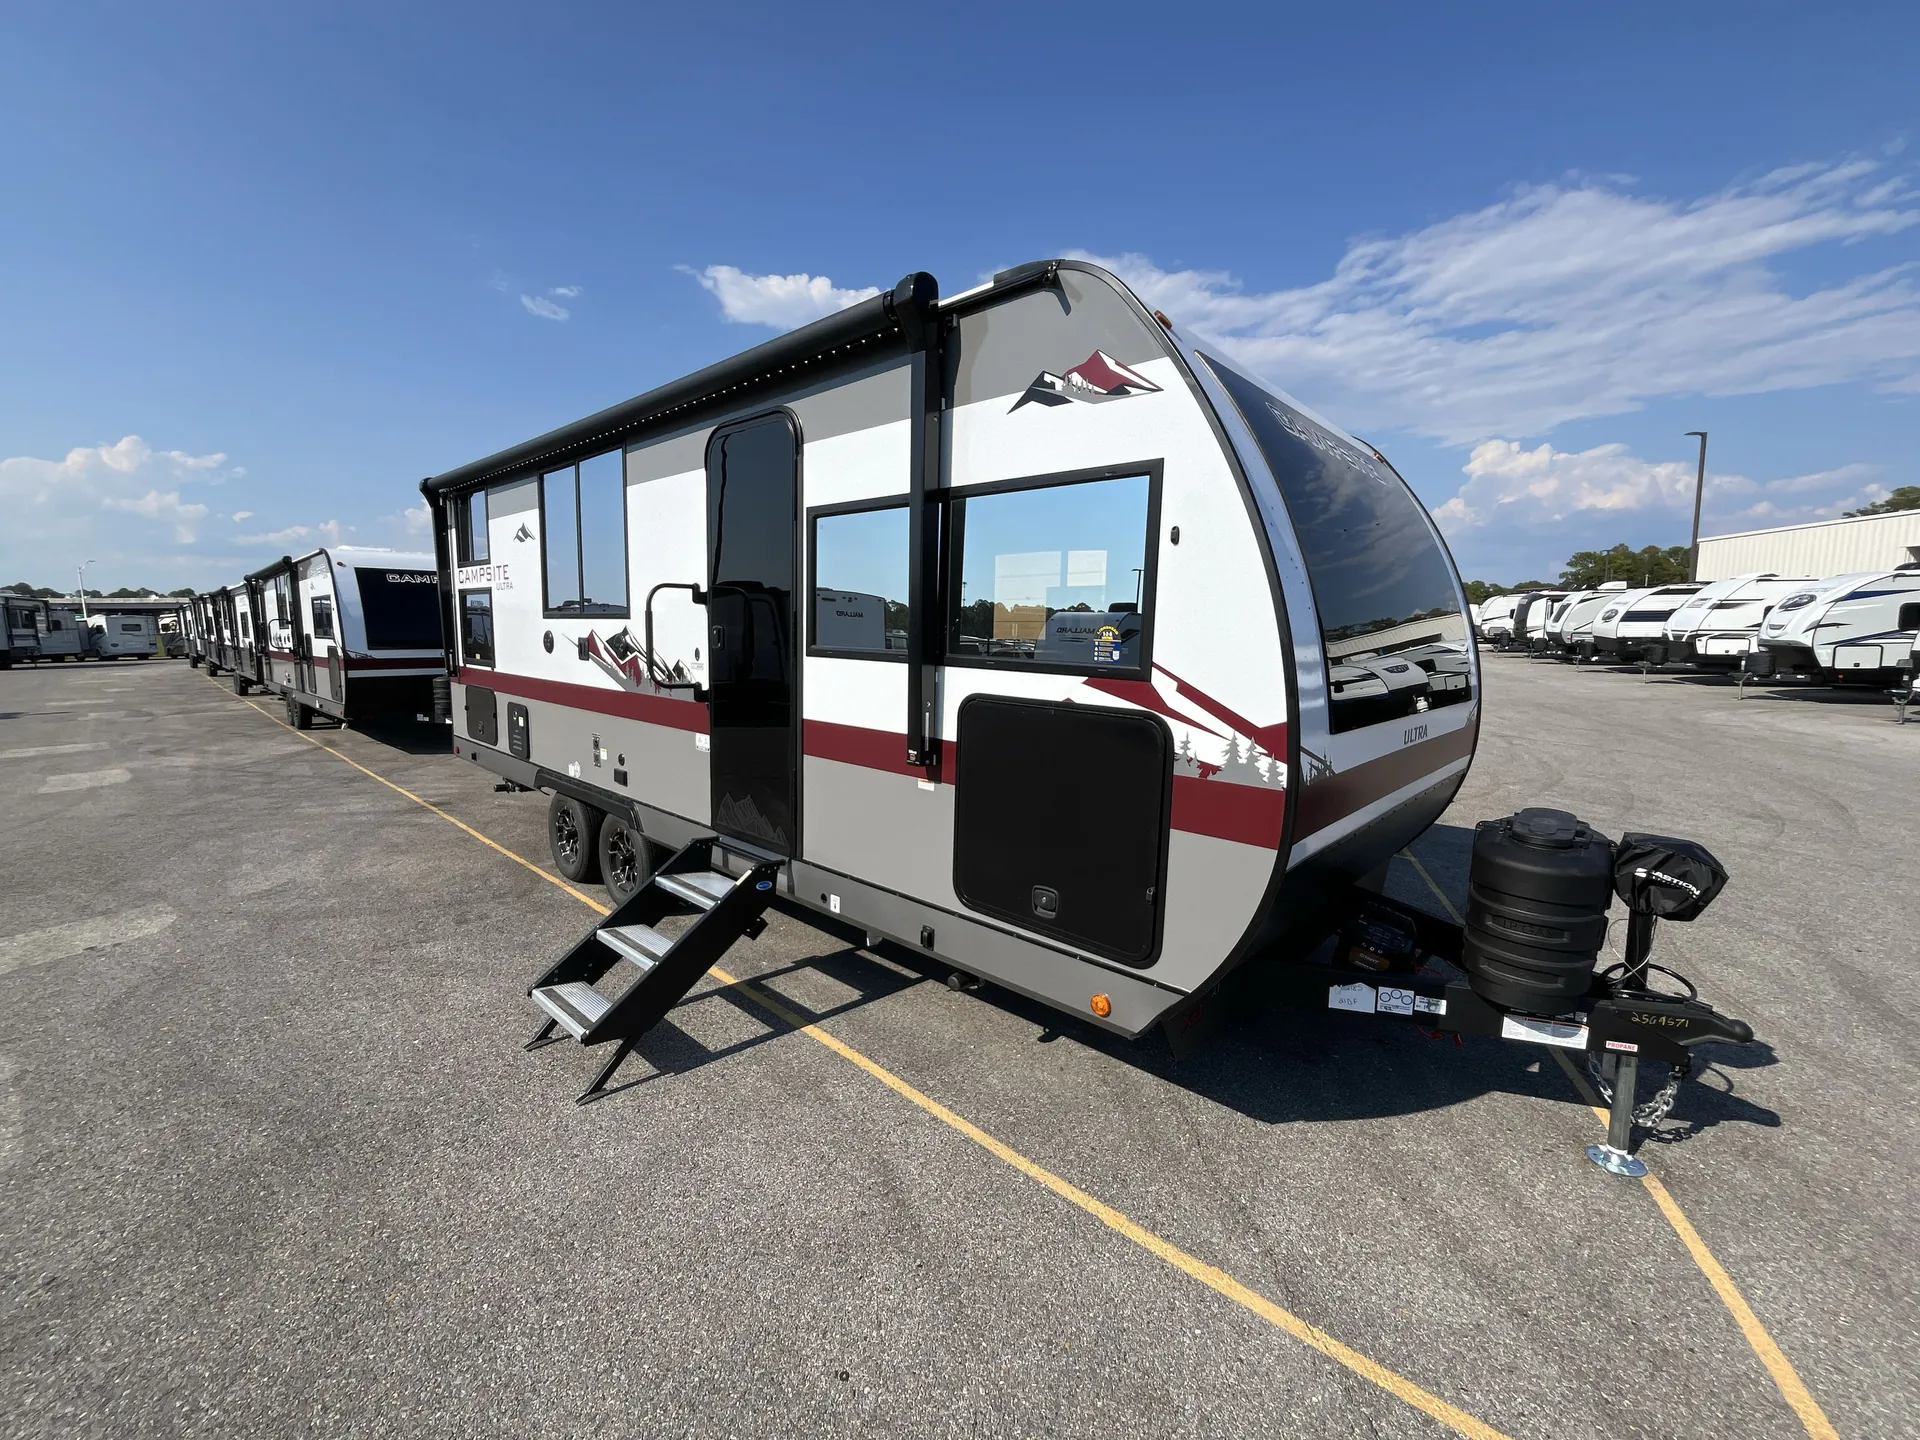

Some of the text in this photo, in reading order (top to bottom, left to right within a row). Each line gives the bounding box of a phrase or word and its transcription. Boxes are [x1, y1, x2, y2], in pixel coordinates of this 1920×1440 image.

[458, 564, 510, 584] CAMPSITE
[496, 581, 513, 591] ULTRA
[1404, 723, 1428, 745] ULTRA
[1607, 1041, 1637, 1051] PROPANE
